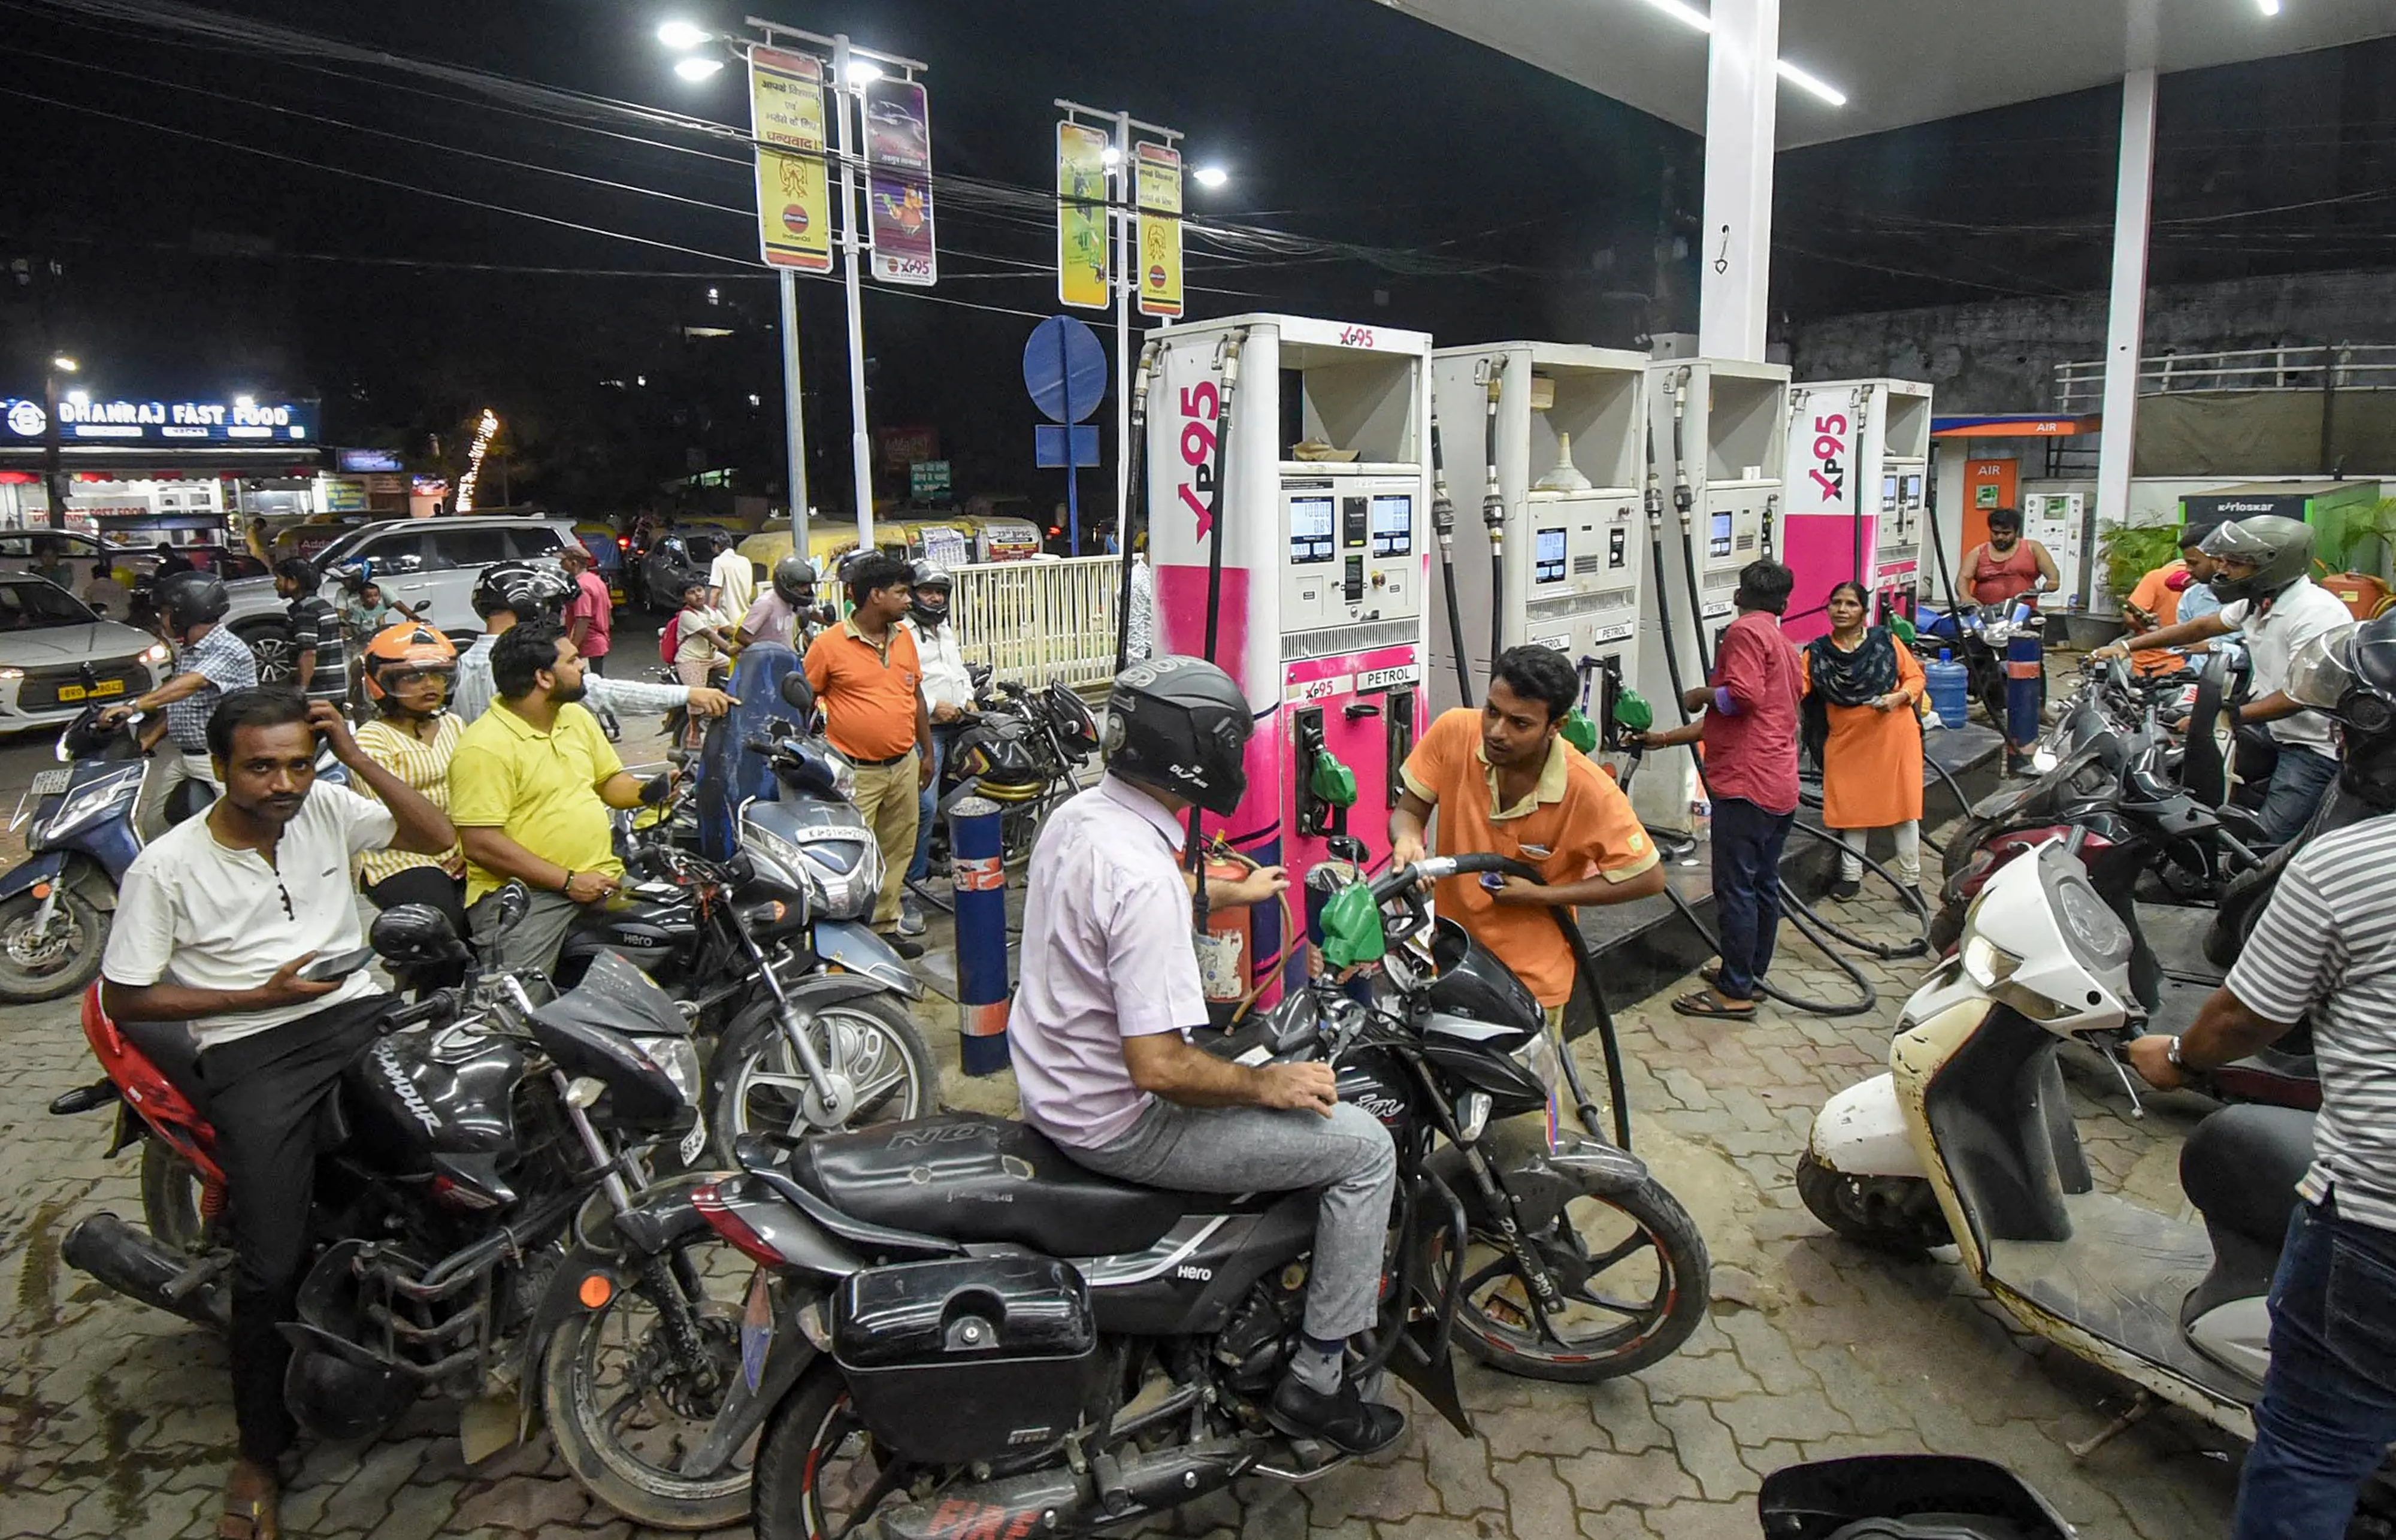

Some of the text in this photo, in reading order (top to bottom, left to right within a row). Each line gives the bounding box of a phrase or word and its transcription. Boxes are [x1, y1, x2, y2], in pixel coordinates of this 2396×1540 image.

[1339, 325, 1374, 348] XP95
[60, 403, 289, 425] DHANRAJ FAST FOOD
[2037, 422, 2057, 432] AIR
[1809, 414, 1847, 503] XP95
[1977, 465, 2001, 475] AIR
[1602, 625, 1627, 638] PETROL
[1368, 668, 1410, 686] PETROL
[1306, 680, 1333, 700] XP95
[624, 933, 653, 947] Hero
[1178, 1265, 1212, 1281] Hero
